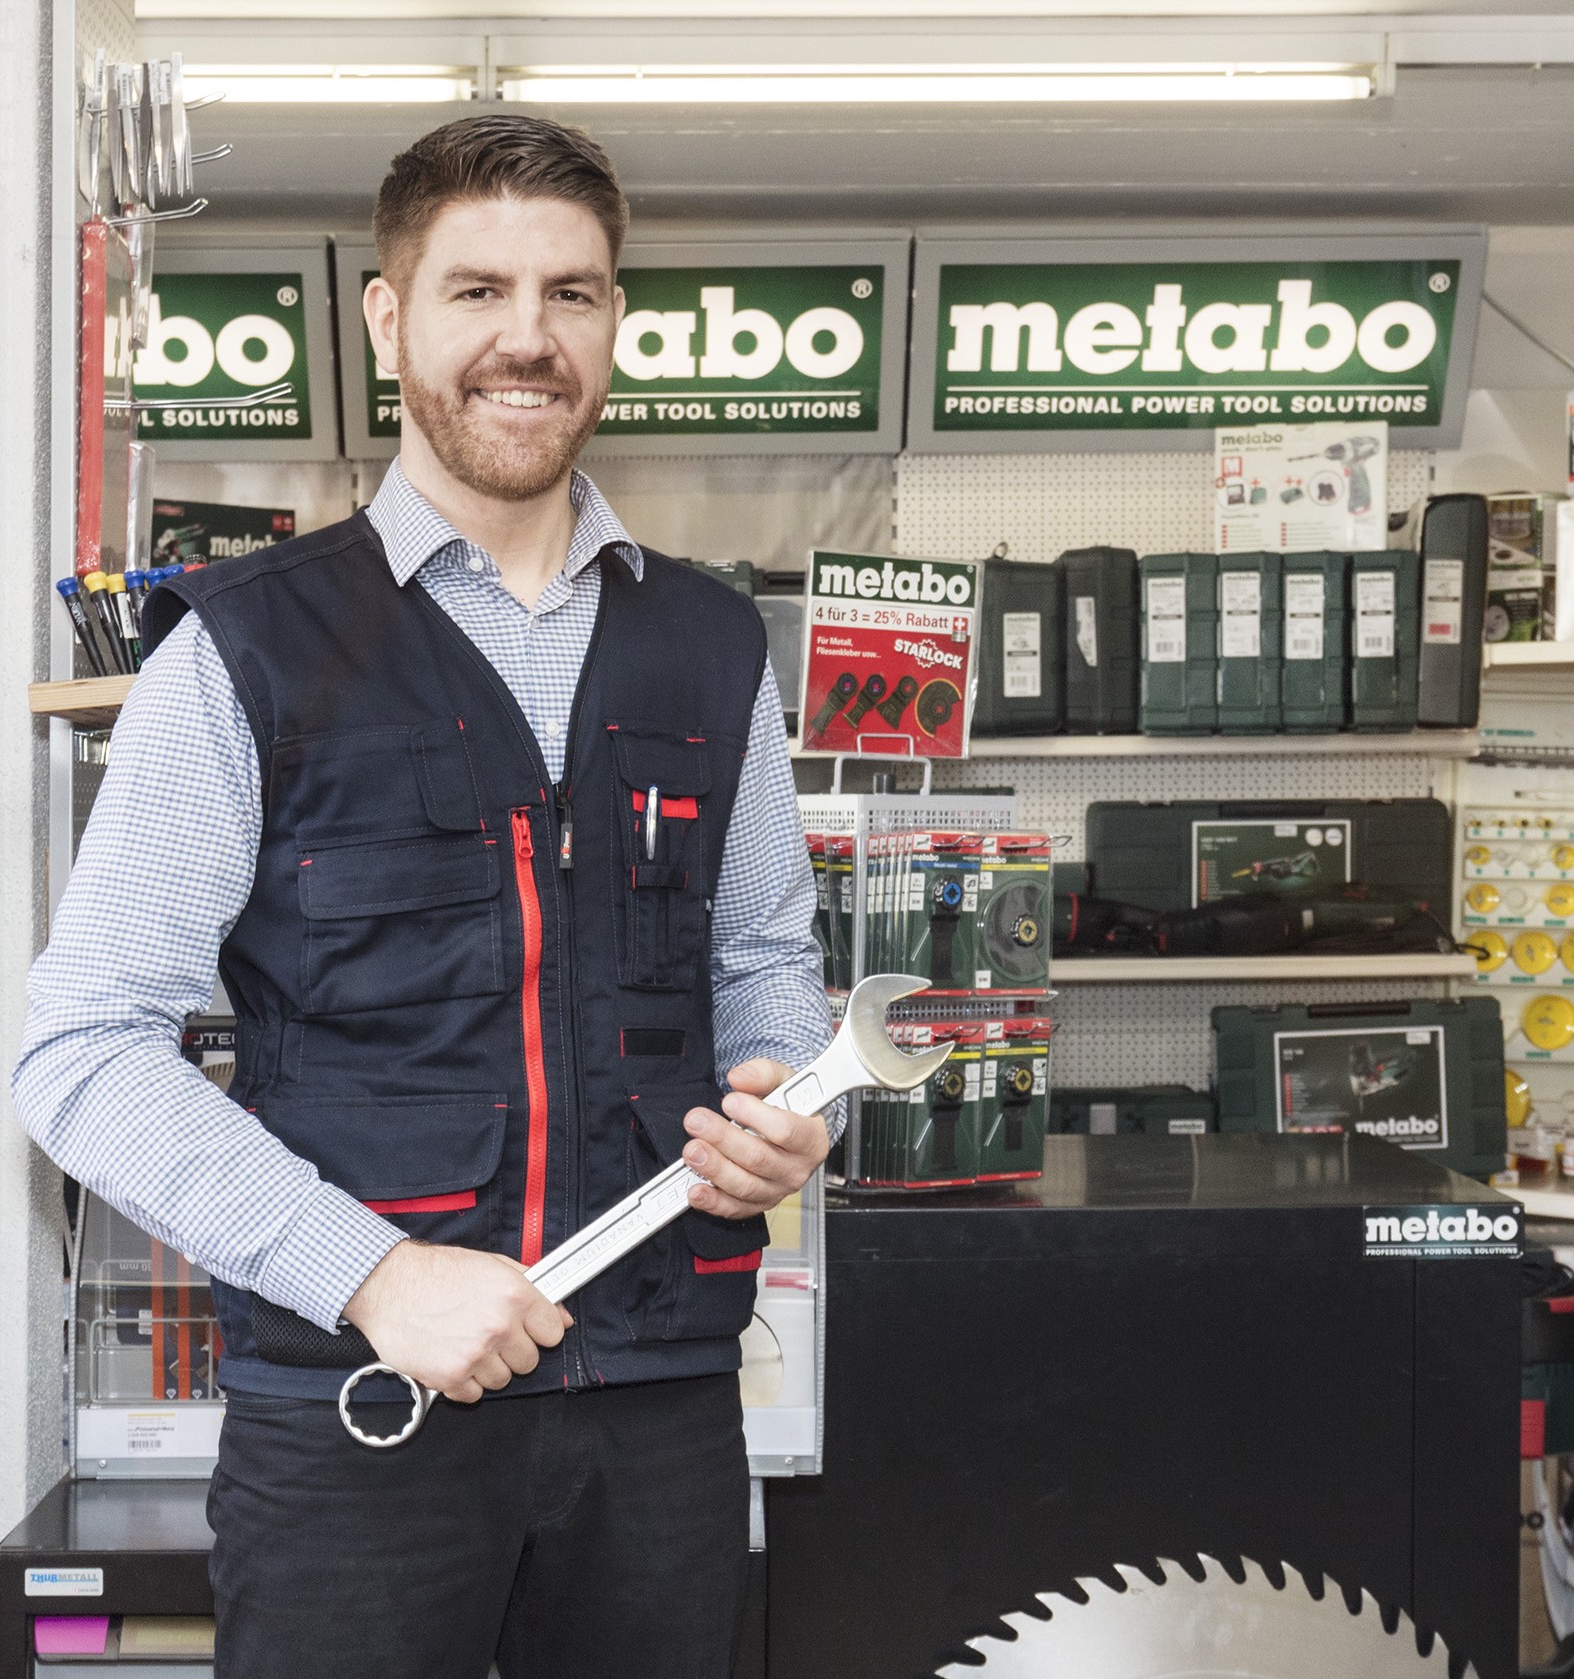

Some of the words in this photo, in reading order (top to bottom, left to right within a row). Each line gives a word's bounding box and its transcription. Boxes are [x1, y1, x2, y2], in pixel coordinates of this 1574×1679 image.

[613, 286, 865, 381] abo
[946, 279, 1437, 375] metabo
[601, 403, 648, 421] WER
[654, 402, 716, 420] TOOL
[724, 400, 862, 419] SOLUTIONS
[944, 396, 1123, 415] PROFESSIONAL
[1130, 396, 1215, 414] POWER
[1222, 395, 1283, 414] TOOL
[1290, 394, 1428, 413] SOLUTIONS
[162, 408, 300, 428] SOLUTIONS
[1221, 432, 1283, 446] metabo
[818, 561, 971, 605] metabo
[816, 606, 824, 621] 4
[827, 607, 847, 622] für
[850, 609, 859, 622] 3
[874, 610, 902, 626] 25%
[905, 613, 949, 629] Rabatt
[817, 636, 829, 646] Für
[829, 637, 853, 647] Metall,
[816, 647, 861, 659] Fliesenkleber
[893, 638, 964, 670] STARLOCK
[911, 853, 940, 862] metabo
[1355, 1116, 1439, 1137] metabo
[1365, 1208, 1519, 1243] metabo
[574, 1213, 645, 1267] VANADIUM
[1365, 1248, 1422, 1257] PROFESSIONAL
[1424, 1247, 1452, 1256] POWER
[1453, 1247, 1473, 1256] TOOL
[1474, 1246, 1518, 1256] SOLUTIONS
[29, 1573, 99, 1583] THURMETALL
